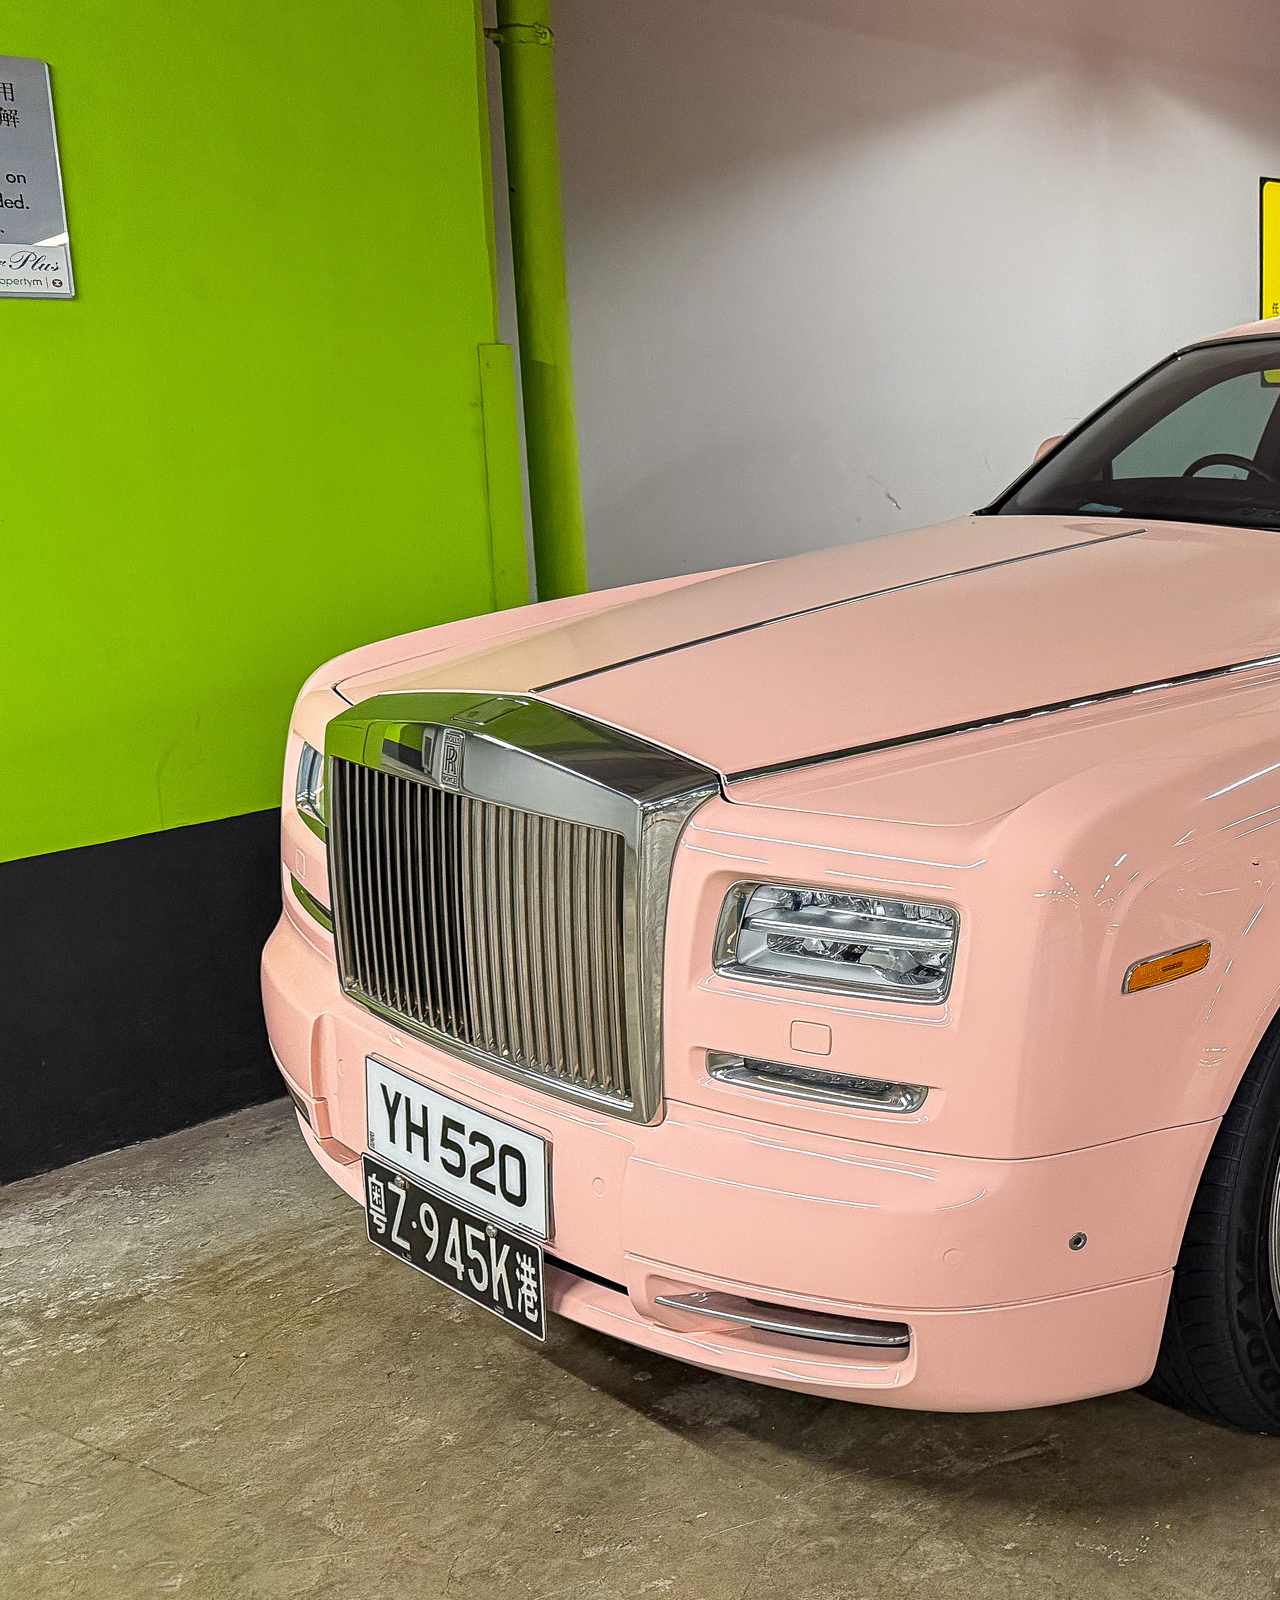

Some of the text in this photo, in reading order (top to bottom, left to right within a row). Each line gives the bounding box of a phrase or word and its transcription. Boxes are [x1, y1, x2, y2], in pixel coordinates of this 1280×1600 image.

[6, 173, 27, 184] on
[9, 250, 59, 271] Plus
[380, 1083, 526, 1208] YH 520
